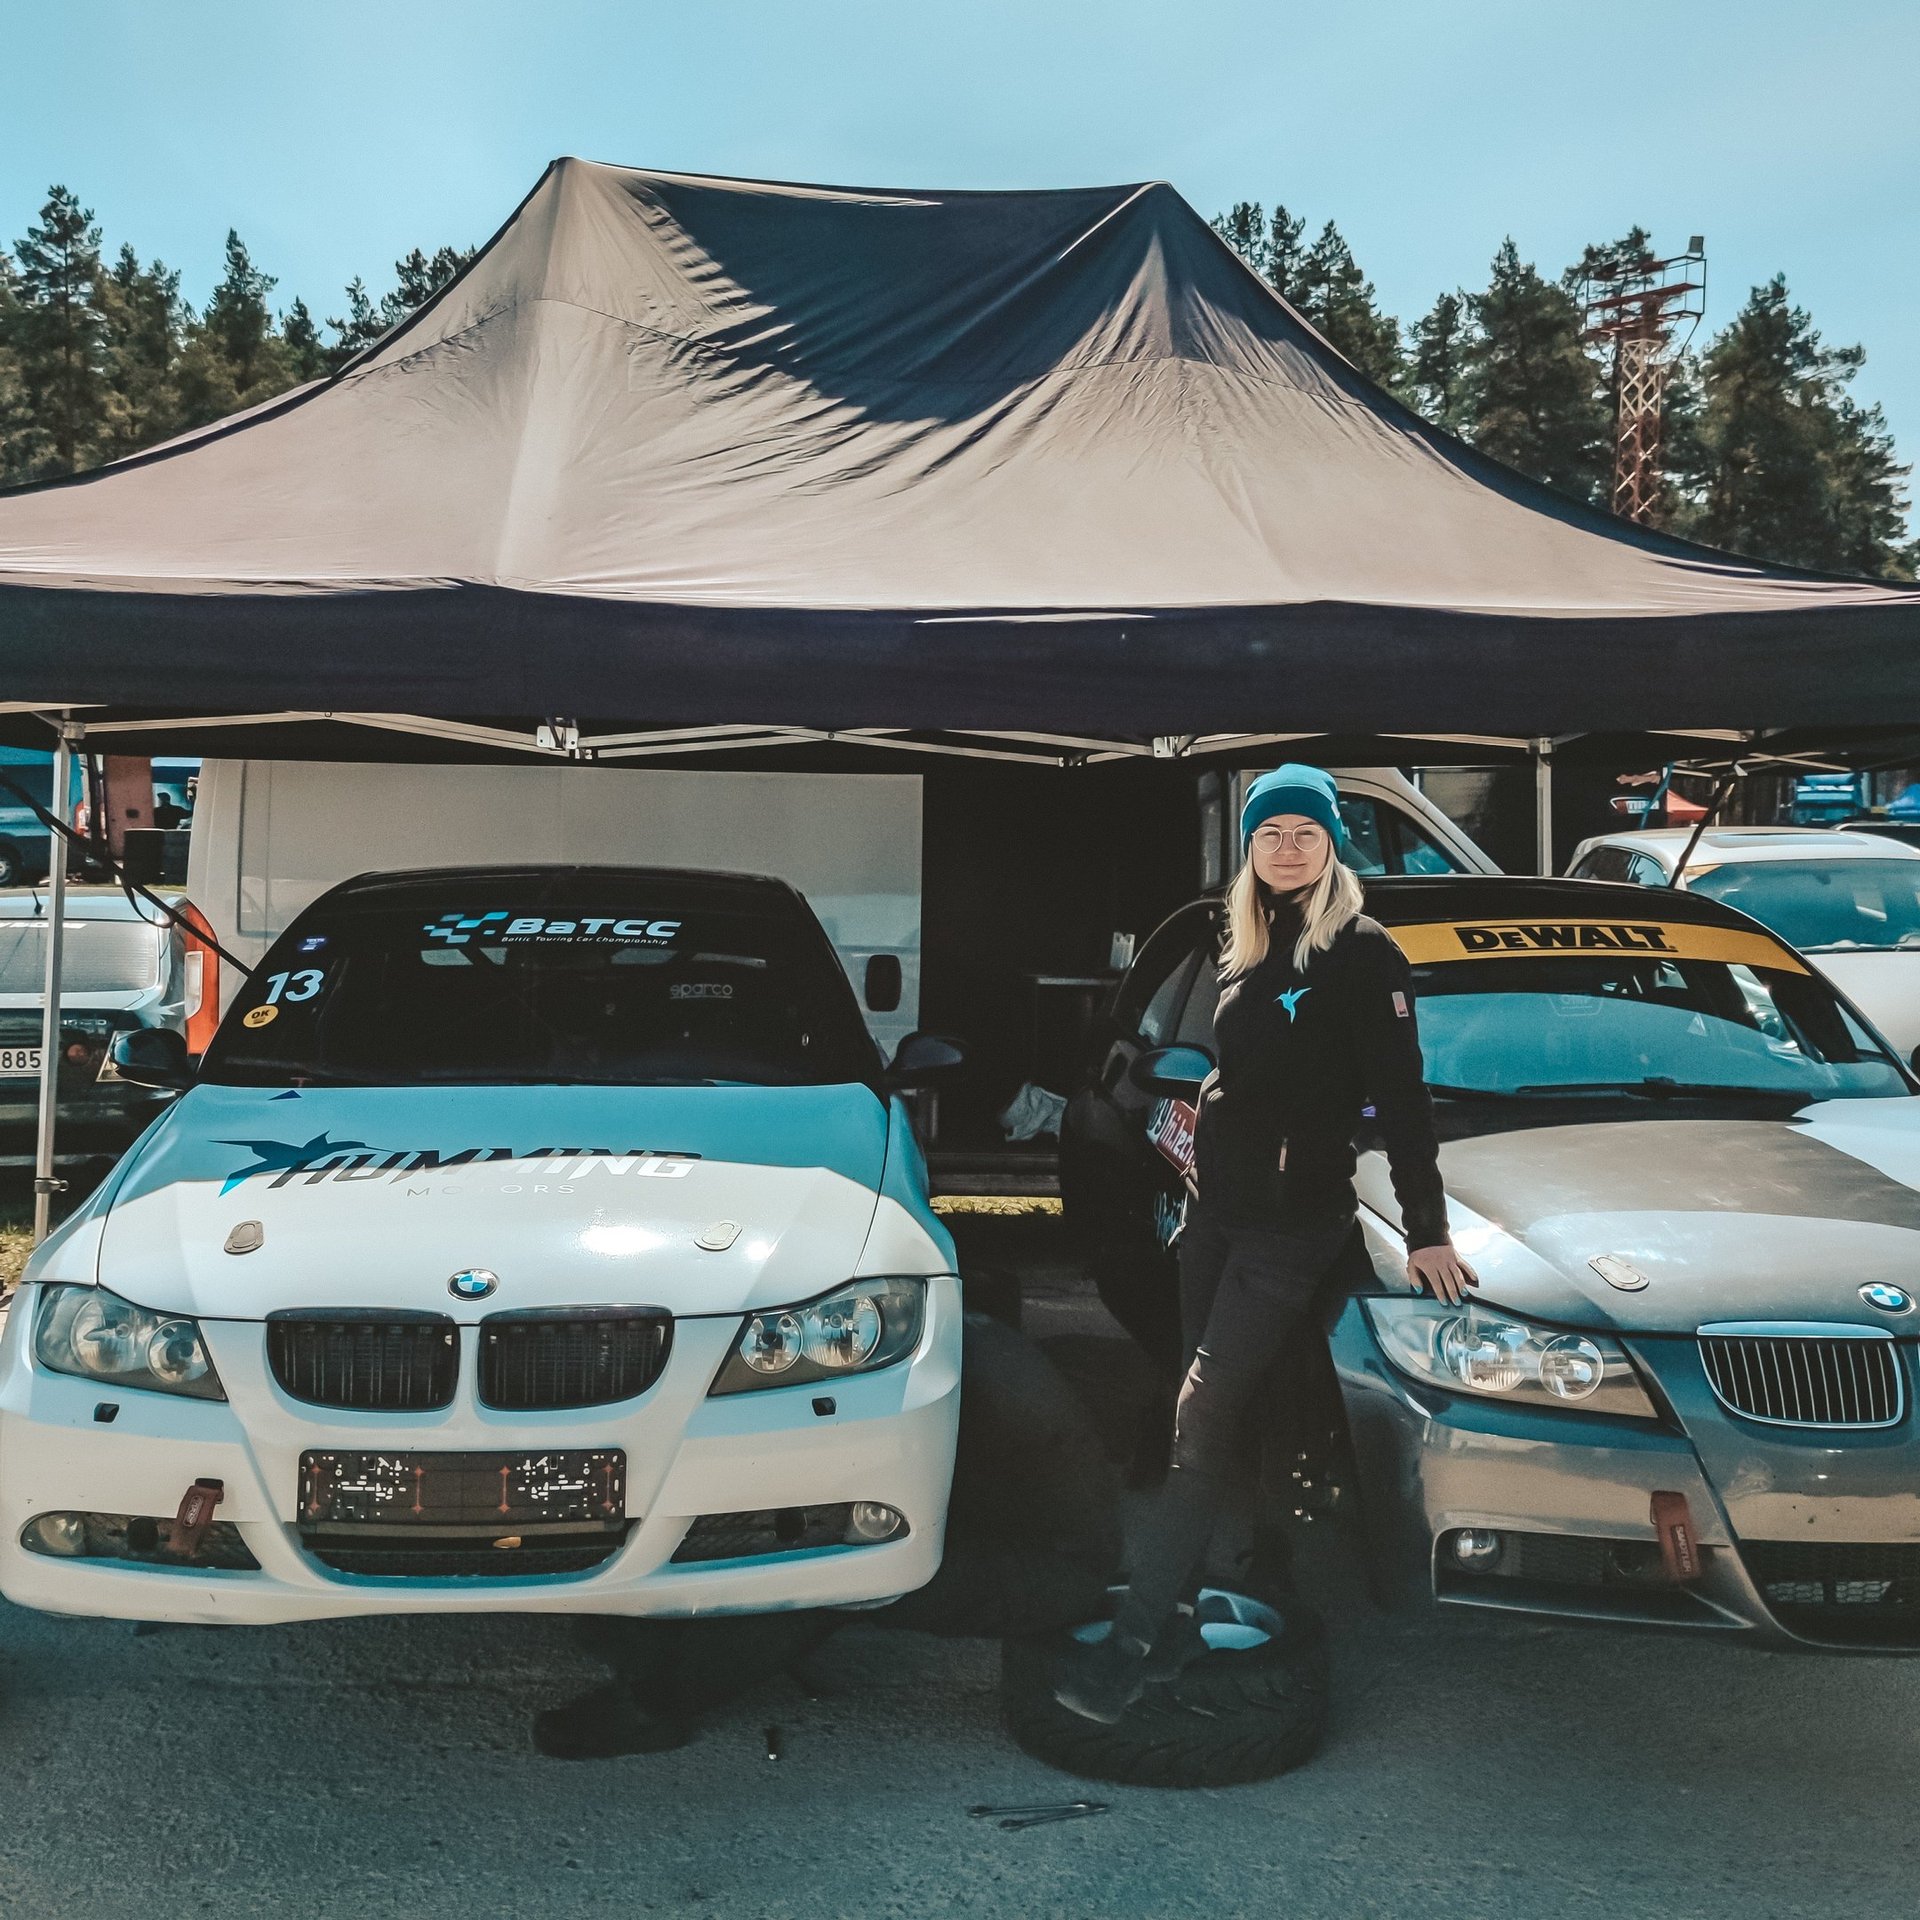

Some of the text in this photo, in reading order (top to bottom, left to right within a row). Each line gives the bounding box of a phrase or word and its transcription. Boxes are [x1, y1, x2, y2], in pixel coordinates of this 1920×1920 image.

[505, 918, 682, 937] BaTCC
[596, 936, 668, 945] Championship
[266, 969, 324, 1004] 13
[670, 984, 733, 998] sparco
[252, 1009, 270, 1019] OK
[2, 1051, 41, 1068] 885
[266, 1147, 703, 1189] HUMMING
[406, 1184, 575, 1197] MOORS
